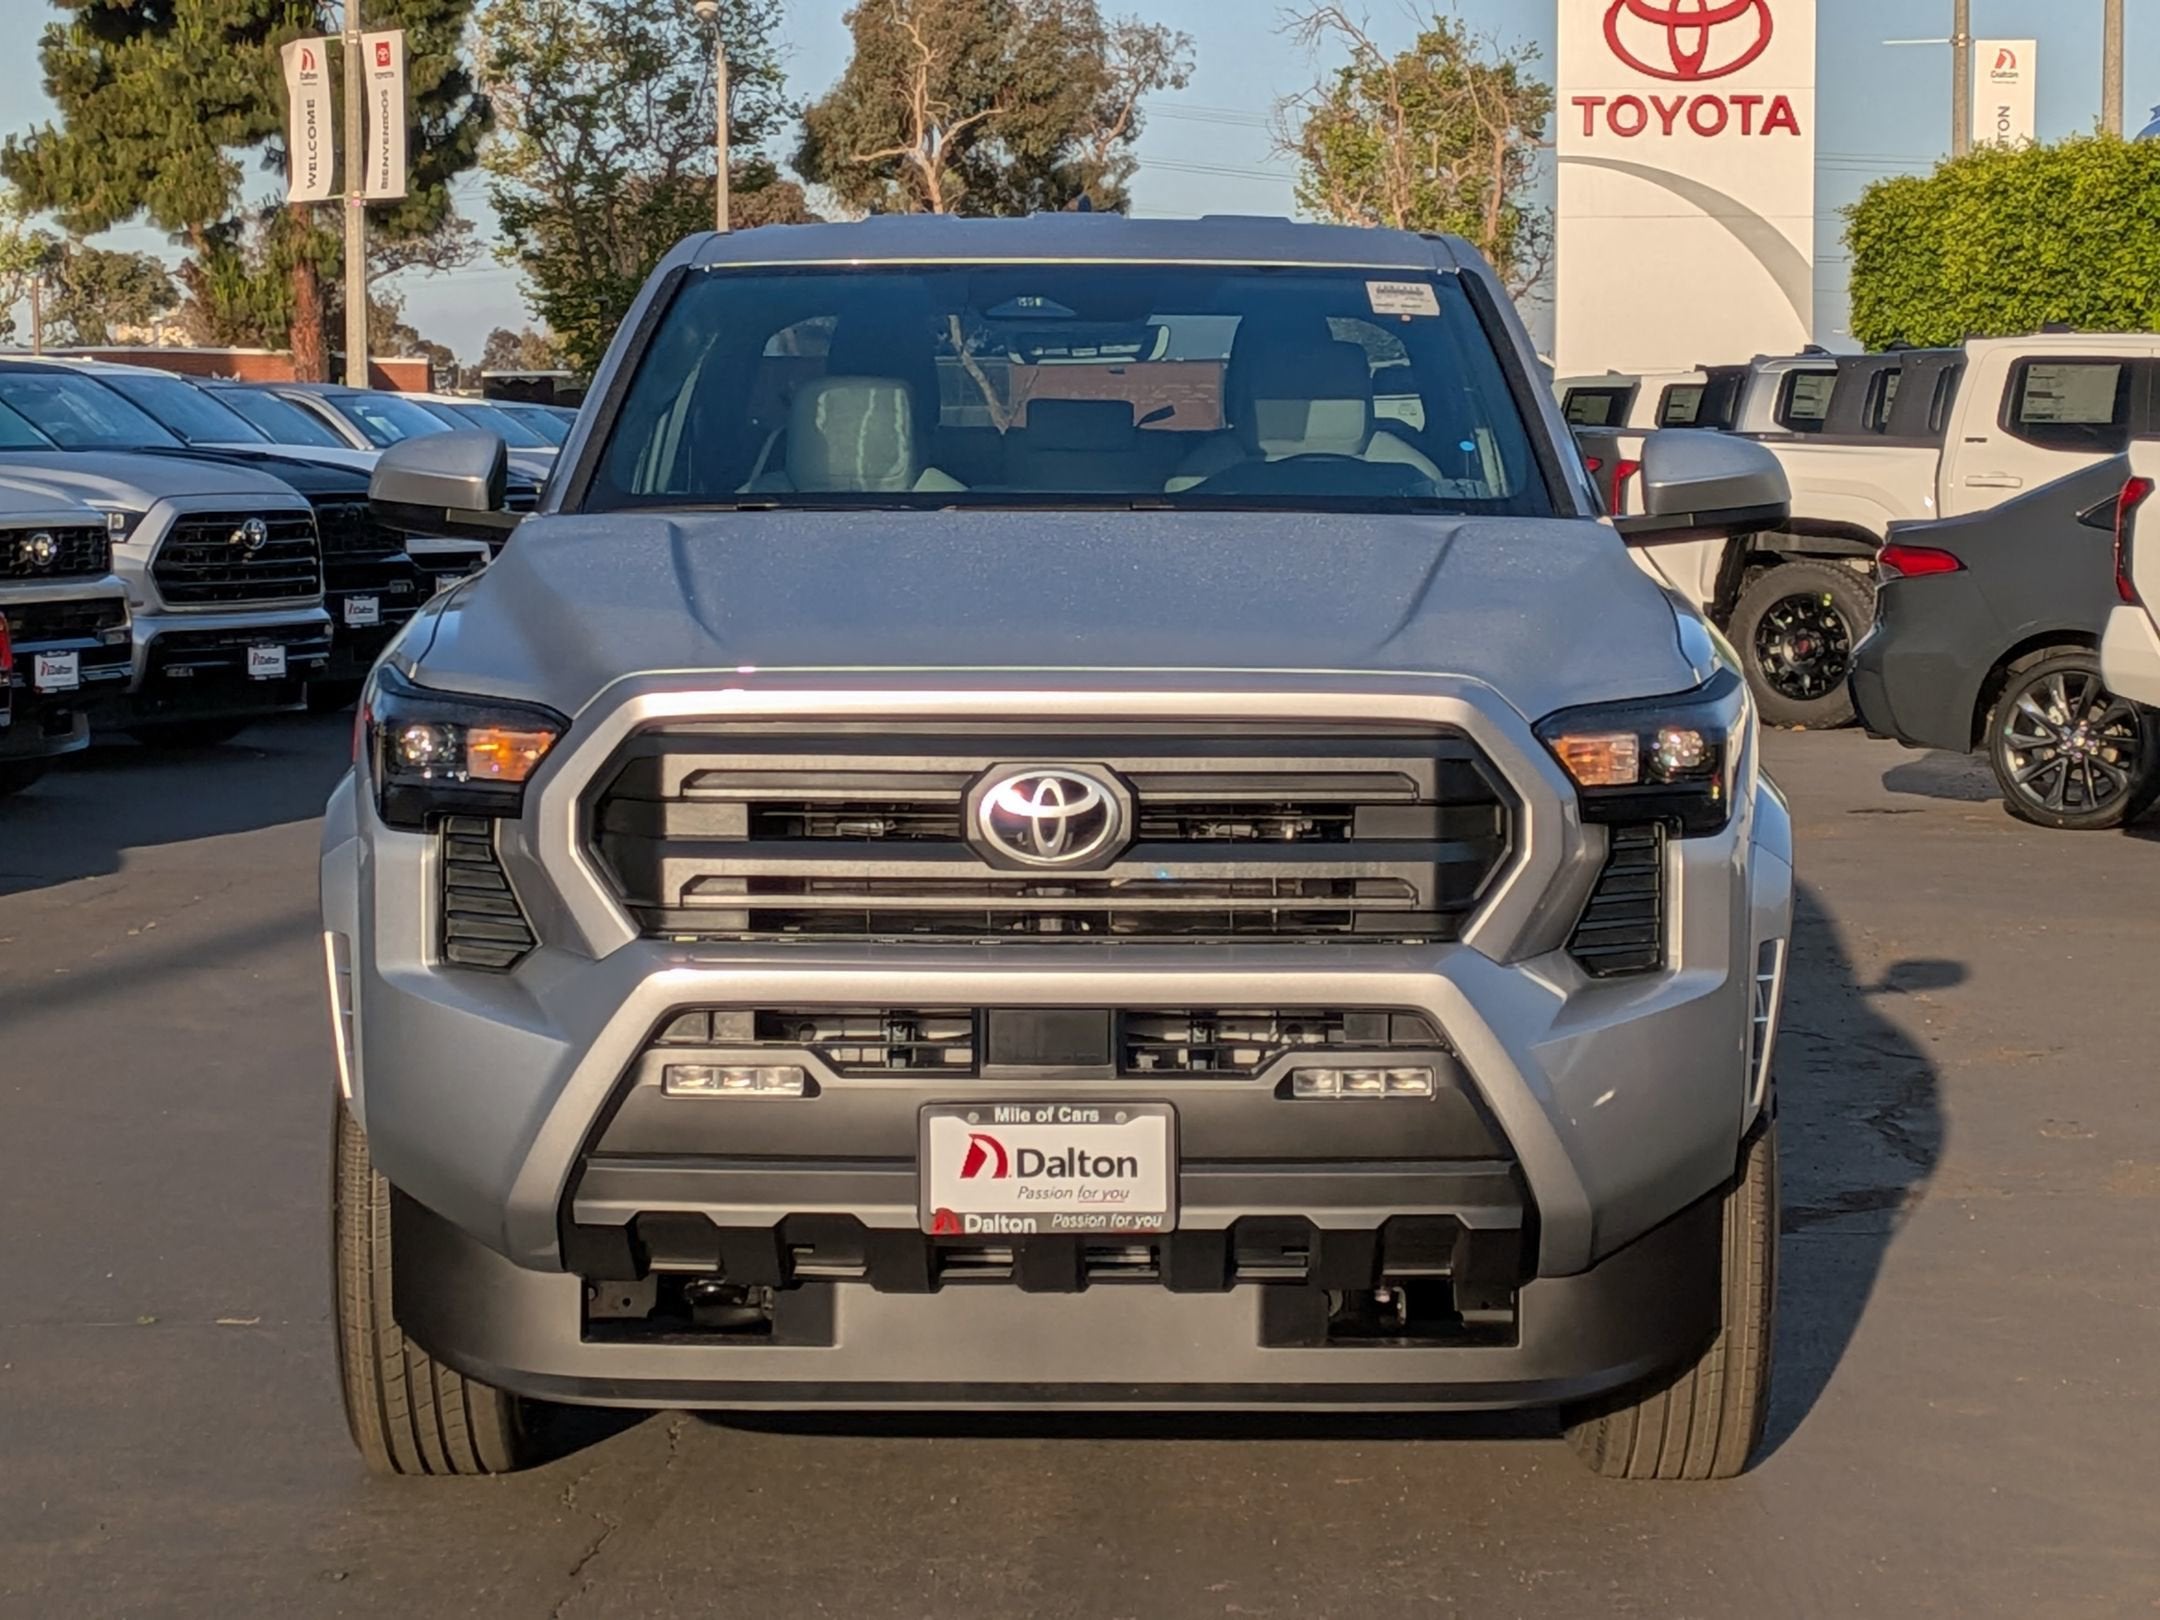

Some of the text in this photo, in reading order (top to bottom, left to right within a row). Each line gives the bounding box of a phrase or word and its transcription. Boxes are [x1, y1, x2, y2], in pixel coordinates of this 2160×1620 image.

[1572, 95, 1801, 137] TOYOTA
[306, 99, 317, 189] WELCOME
[381, 89, 390, 190] BIENVENIDOS
[994, 1107, 1099, 1122] Mile of Cars
[1016, 1147, 1138, 1178] Dalton
[1017, 1185, 1130, 1203] Passion for you
[964, 1213, 1162, 1234] Dalton Passion for you
